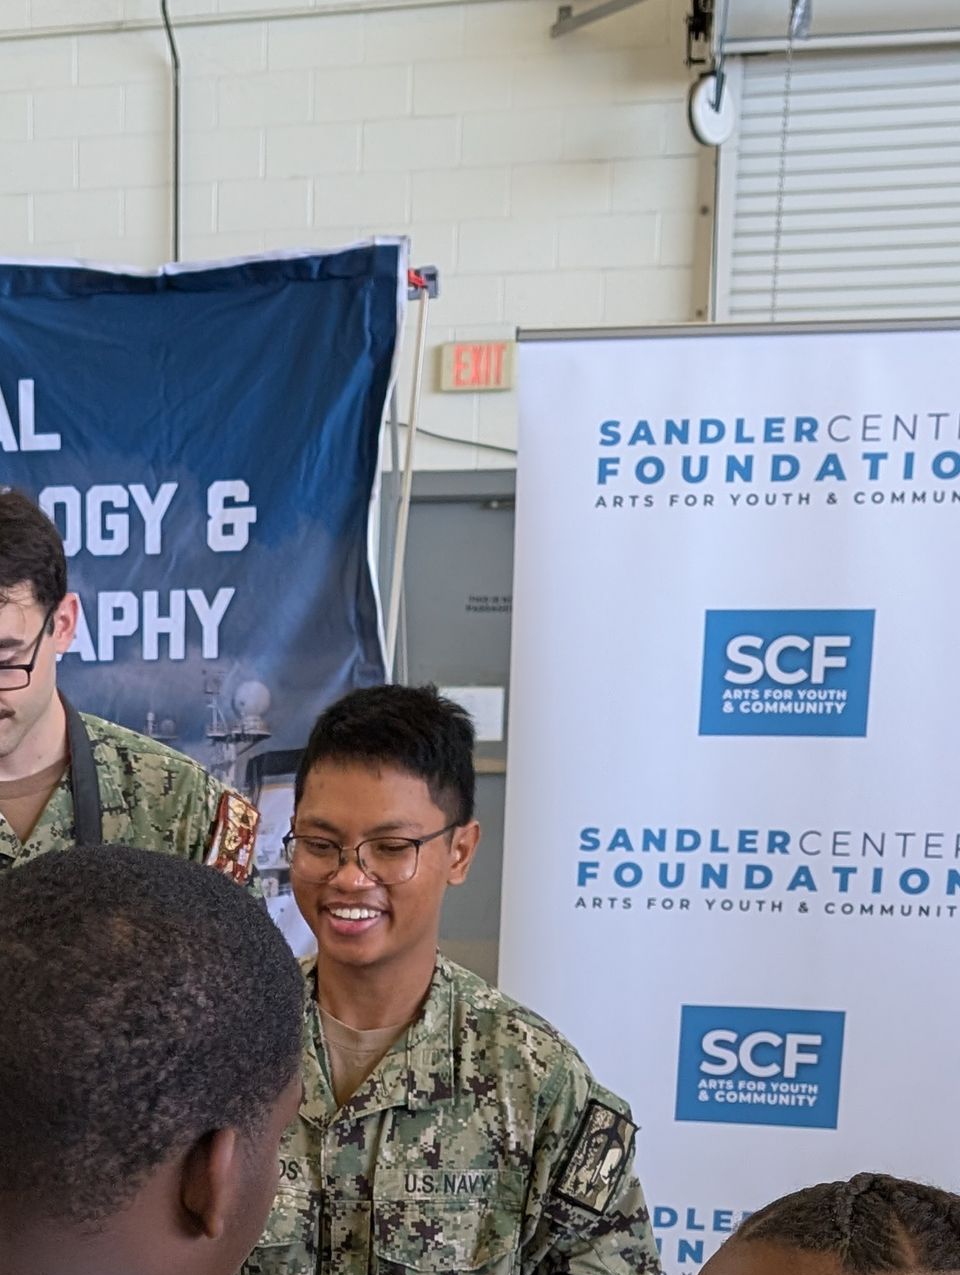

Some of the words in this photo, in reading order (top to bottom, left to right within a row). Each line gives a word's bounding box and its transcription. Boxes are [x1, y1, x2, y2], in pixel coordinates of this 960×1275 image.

[454, 344, 507, 386] EXIT
[599, 412, 960, 446] SANDLERCENT
[595, 494, 654, 508] ARTS
[668, 494, 715, 507] FOR
[730, 492, 811, 506] YOUTH
[826, 492, 838, 505] &
[207, 480, 256, 552] &
[724, 635, 851, 685] SCF
[722, 689, 760, 700] ARTS
[764, 689, 793, 700] FOR
[798, 689, 848, 700] YOUTH
[722, 702, 734, 713] &
[739, 702, 847, 714] COMMUNITY
[575, 897, 632, 909] ARTS
[647, 898, 690, 910] FOR
[705, 899, 783, 912] YOUTH
[798, 901, 809, 913] &
[699, 1029, 822, 1078] SCF
[698, 1079, 733, 1090] ARTS
[738, 1081, 766, 1091] FOR
[770, 1082, 818, 1094] YOUTH
[698, 1090, 709, 1102] &
[714, 1091, 817, 1107] COMMUNITY
[405, 1174, 438, 1193] U.S.
[444, 1174, 493, 1194] NAVY
